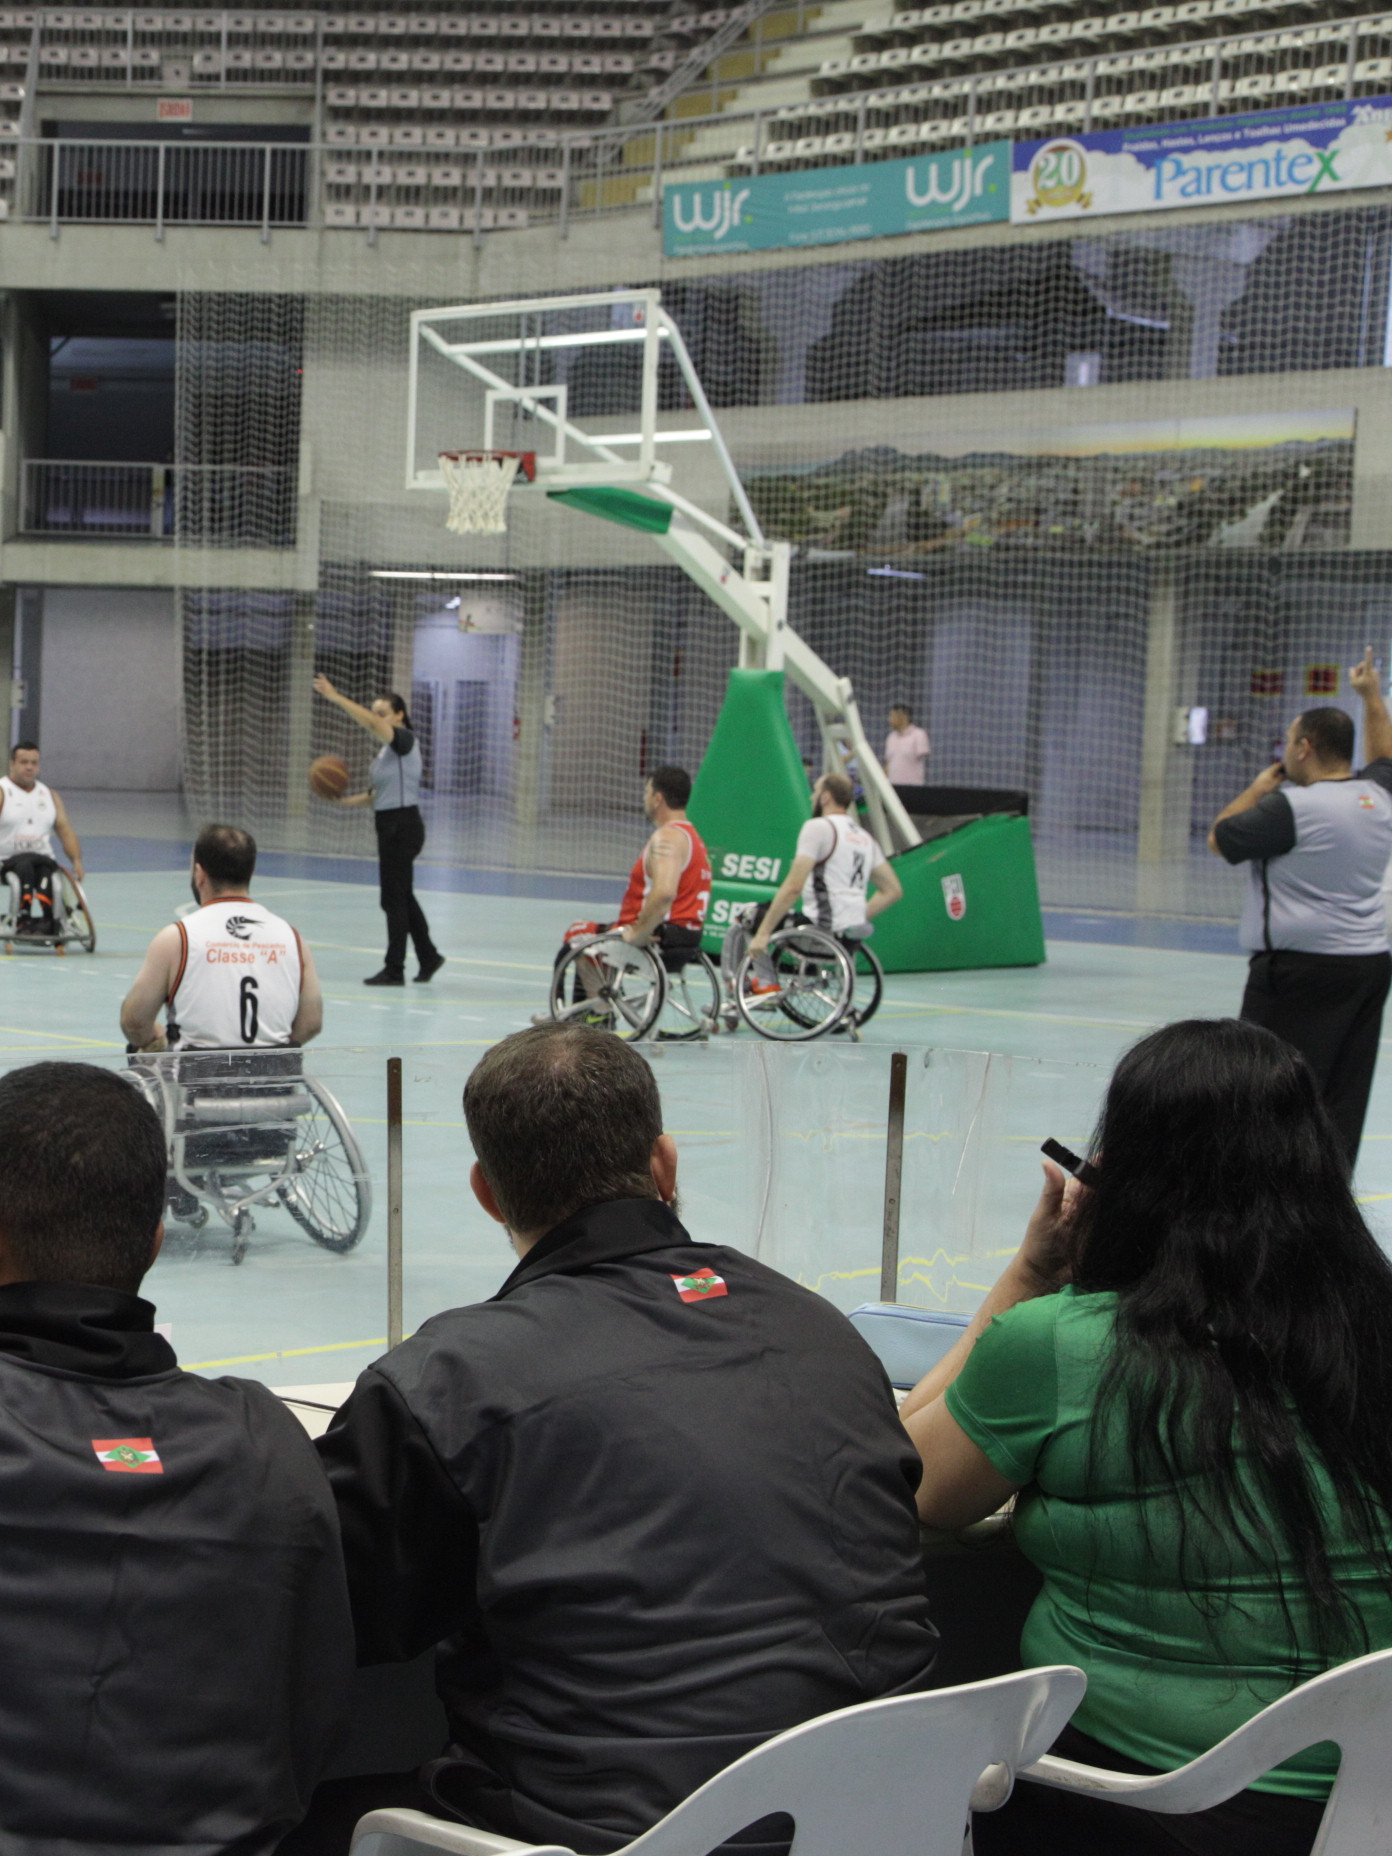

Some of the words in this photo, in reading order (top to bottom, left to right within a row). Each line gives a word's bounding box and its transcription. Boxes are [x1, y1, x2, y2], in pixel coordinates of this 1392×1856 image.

[1038, 151, 1081, 190] 20
[1153, 149, 1341, 200] Parentex
[721, 853, 781, 882] SESI
[206, 948, 256, 964] Classe
[240, 976, 258, 1043] 6
